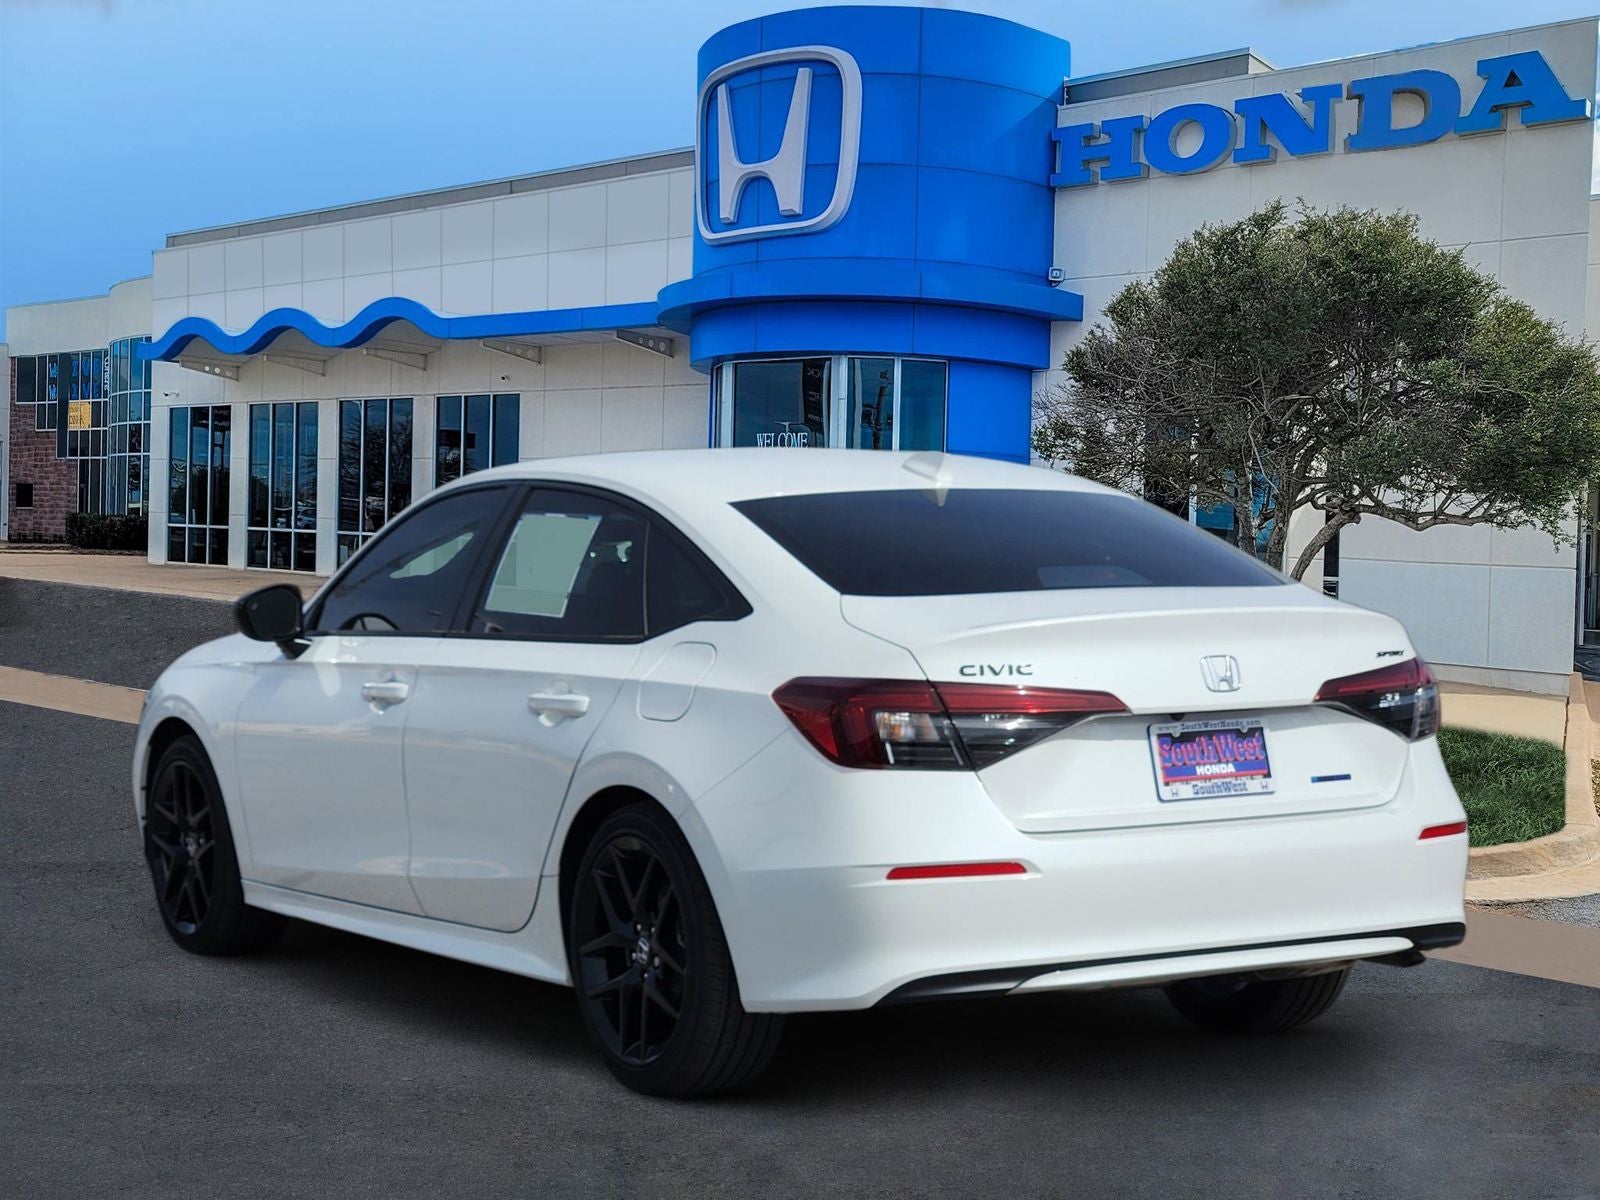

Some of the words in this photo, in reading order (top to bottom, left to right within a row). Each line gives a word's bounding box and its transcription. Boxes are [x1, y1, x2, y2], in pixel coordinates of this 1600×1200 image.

[1051, 50, 1590, 188] HONDA
[756, 432, 808, 448] WELCOME
[959, 664, 1033, 676] CIVIC
[1158, 732, 1266, 768] SouthWest
[1195, 763, 1236, 775] HONDA
[1193, 781, 1248, 795] SouthWest
